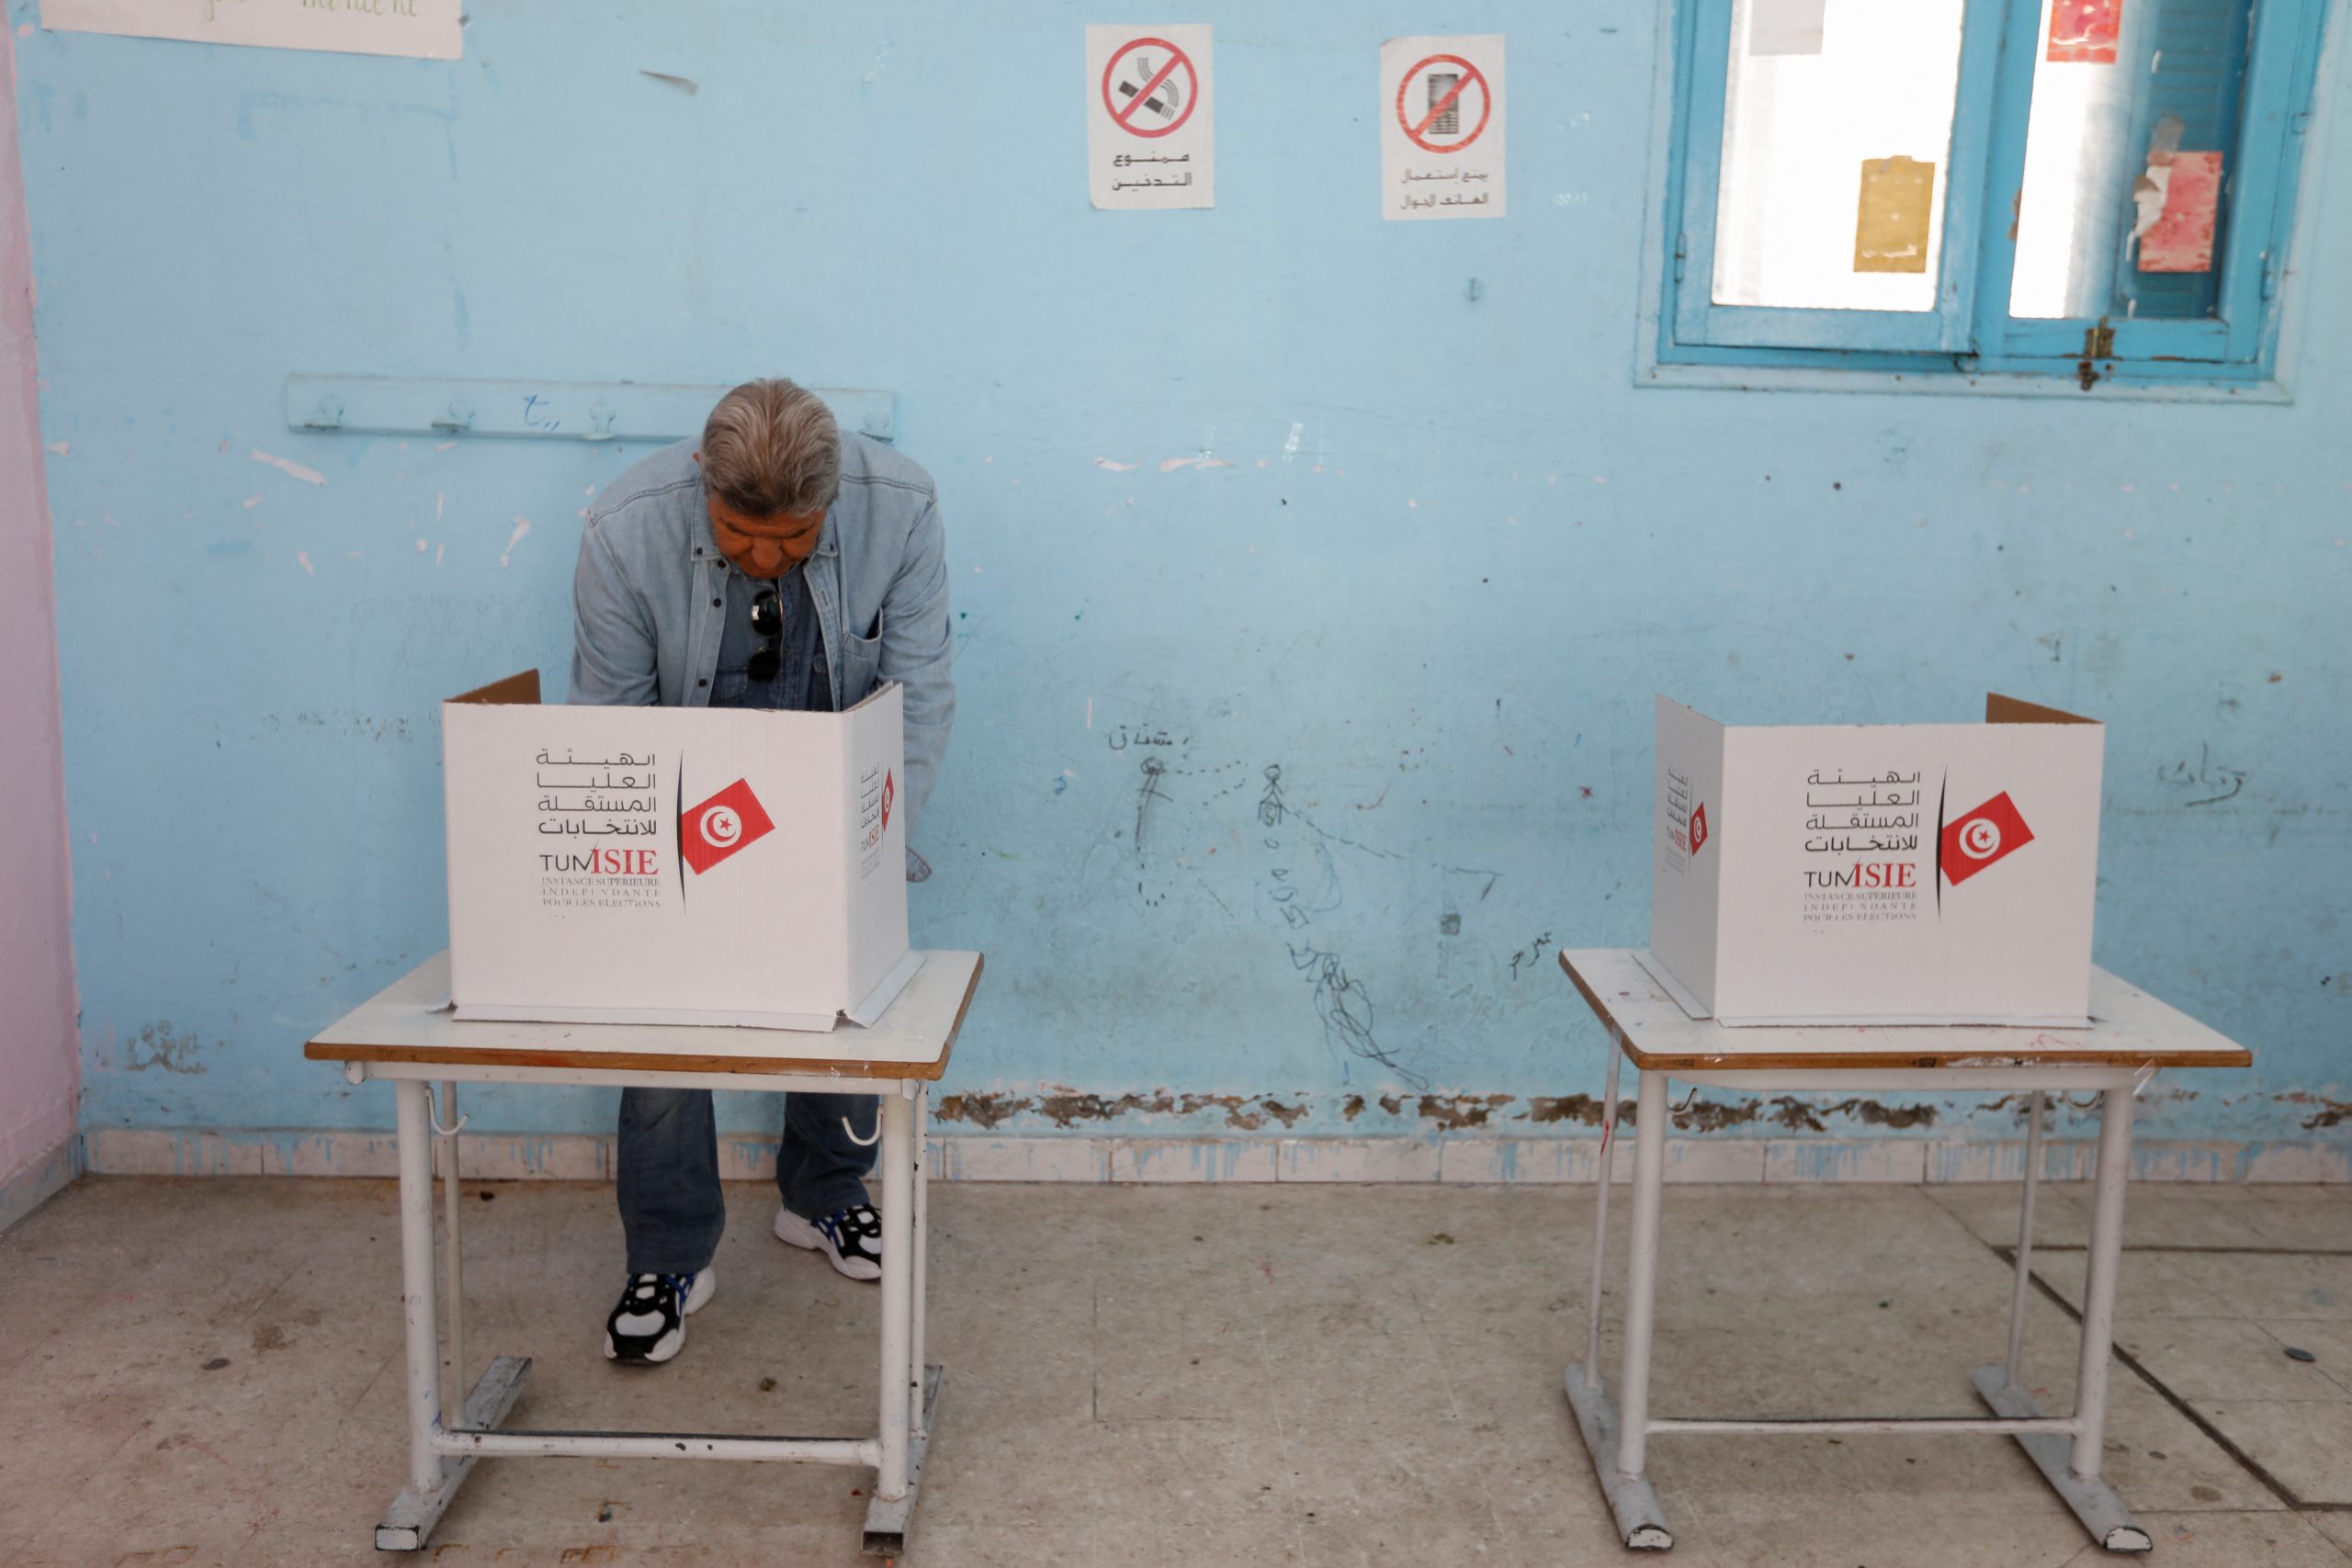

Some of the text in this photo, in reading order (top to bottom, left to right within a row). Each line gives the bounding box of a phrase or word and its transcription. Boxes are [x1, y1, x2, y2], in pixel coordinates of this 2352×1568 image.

[1113, 151, 1190, 167] ممنوع
[1112, 172, 1192, 192] التدخين
[1400, 192, 1488, 209] الهاتف الجوال
[537, 748, 656, 771] الهيئة
[537, 773, 656, 793] العليا
[1806, 768, 1921, 789] الهيئة
[537, 795, 657, 813] المستقلة
[1805, 790, 1920, 811] العليا
[538, 818, 657, 840] للانتخابات
[1805, 812, 1919, 830] المستقلة
[1804, 835, 1918, 856] للانتخابات
[538, 842, 659, 874] TUNISIE
[542, 876, 594, 886] INSTANCE
[1803, 859, 1917, 887] TUNISIE
